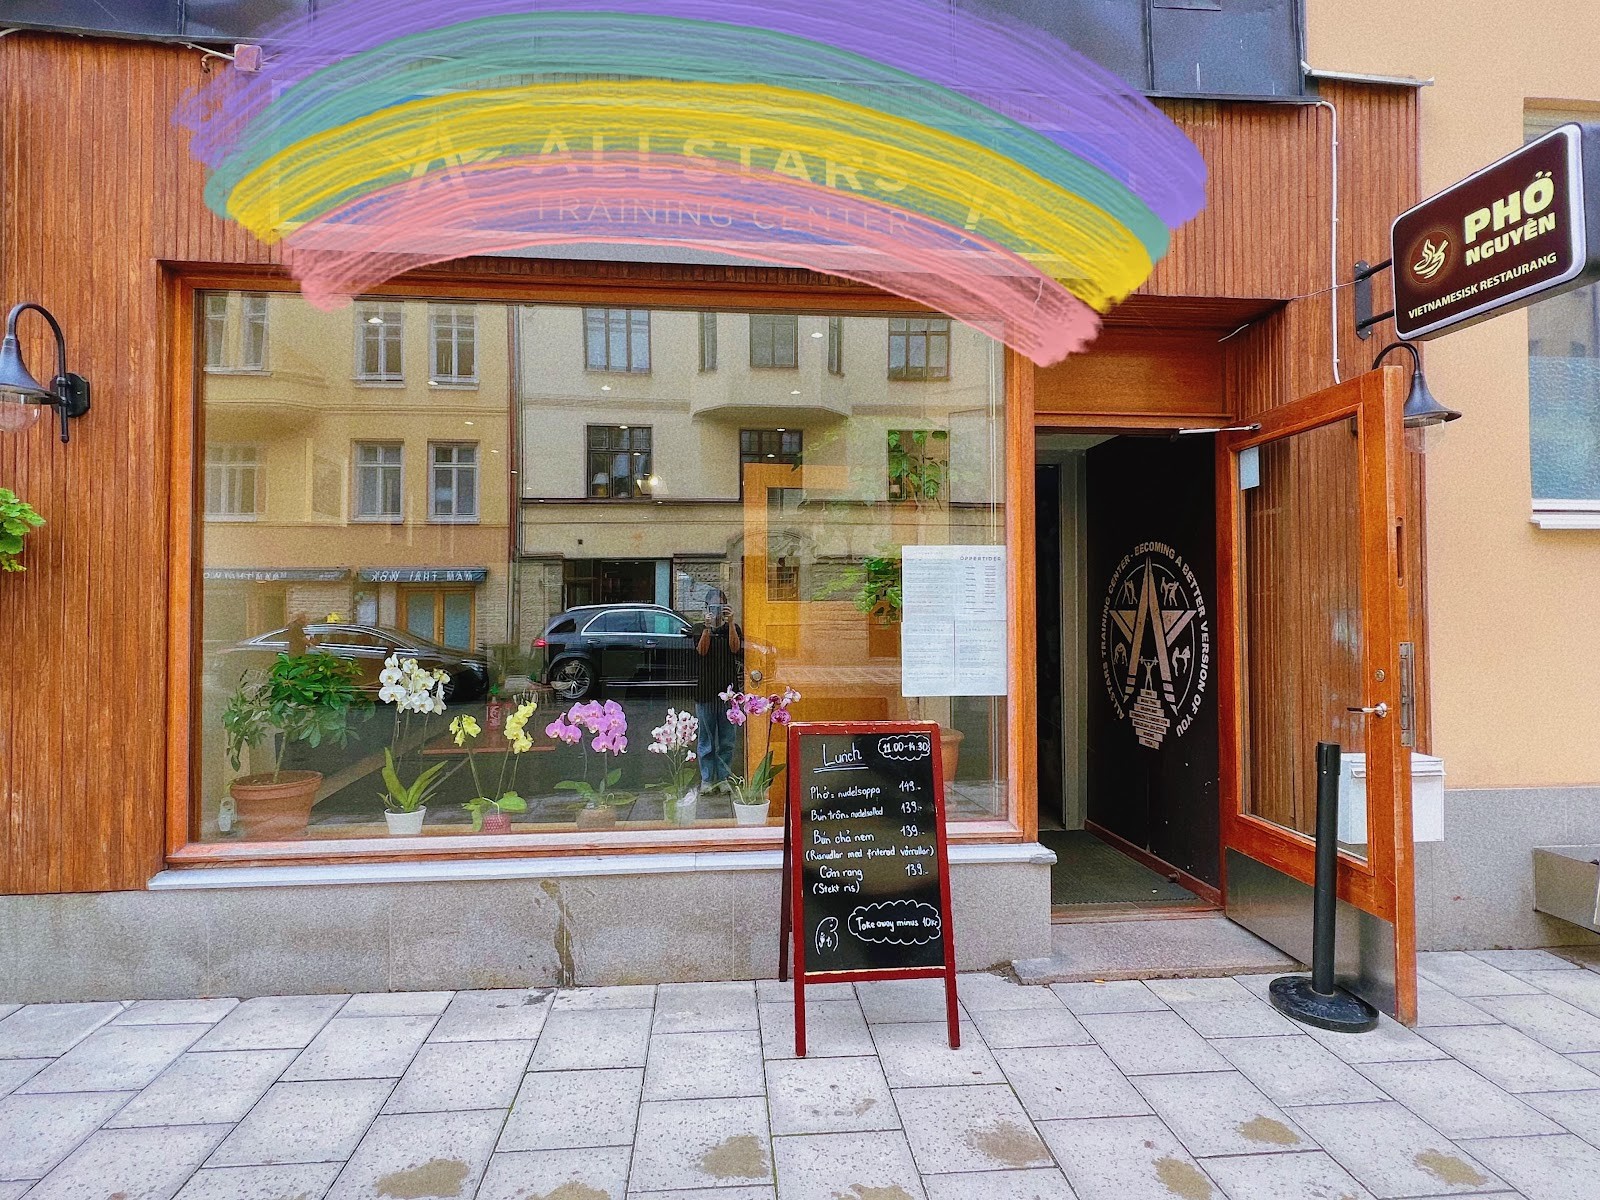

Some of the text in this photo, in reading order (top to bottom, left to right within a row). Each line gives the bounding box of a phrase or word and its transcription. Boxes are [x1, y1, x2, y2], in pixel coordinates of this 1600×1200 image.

[530, 128, 908, 192] ALLSTARS
[534, 194, 910, 235] TRAINING CENTER
[1408, 252, 1557, 318] VIETNAMESISK RESTAURANG
[1134, 541, 1176, 560] BECOMING
[1174, 555, 1183, 567] A
[1108, 554, 1130, 594] CENTER
[1182, 563, 1206, 618] BETTER
[1101, 596, 1110, 659] TRAINING
[1197, 620, 1210, 693] VERSION
[1191, 693, 1202, 715] OF
[1175, 713, 1194, 737] YOU
[822, 742, 863, 767] Lunch
[837, 785, 881, 799] nudelsoppa
[850, 806, 884, 819] nudelsallad
[813, 830, 831, 844] Bún
[834, 830, 851, 843] chả
[854, 833, 875, 842] nem
[847, 848, 863, 859] med
[867, 845, 896, 859] friterad
[842, 868, 864, 881] rang
[812, 880, 860, 895] (Stekt ris)
[855, 916, 876, 931] Take
[876, 920, 895, 932] away
[896, 918, 919, 927] minus
